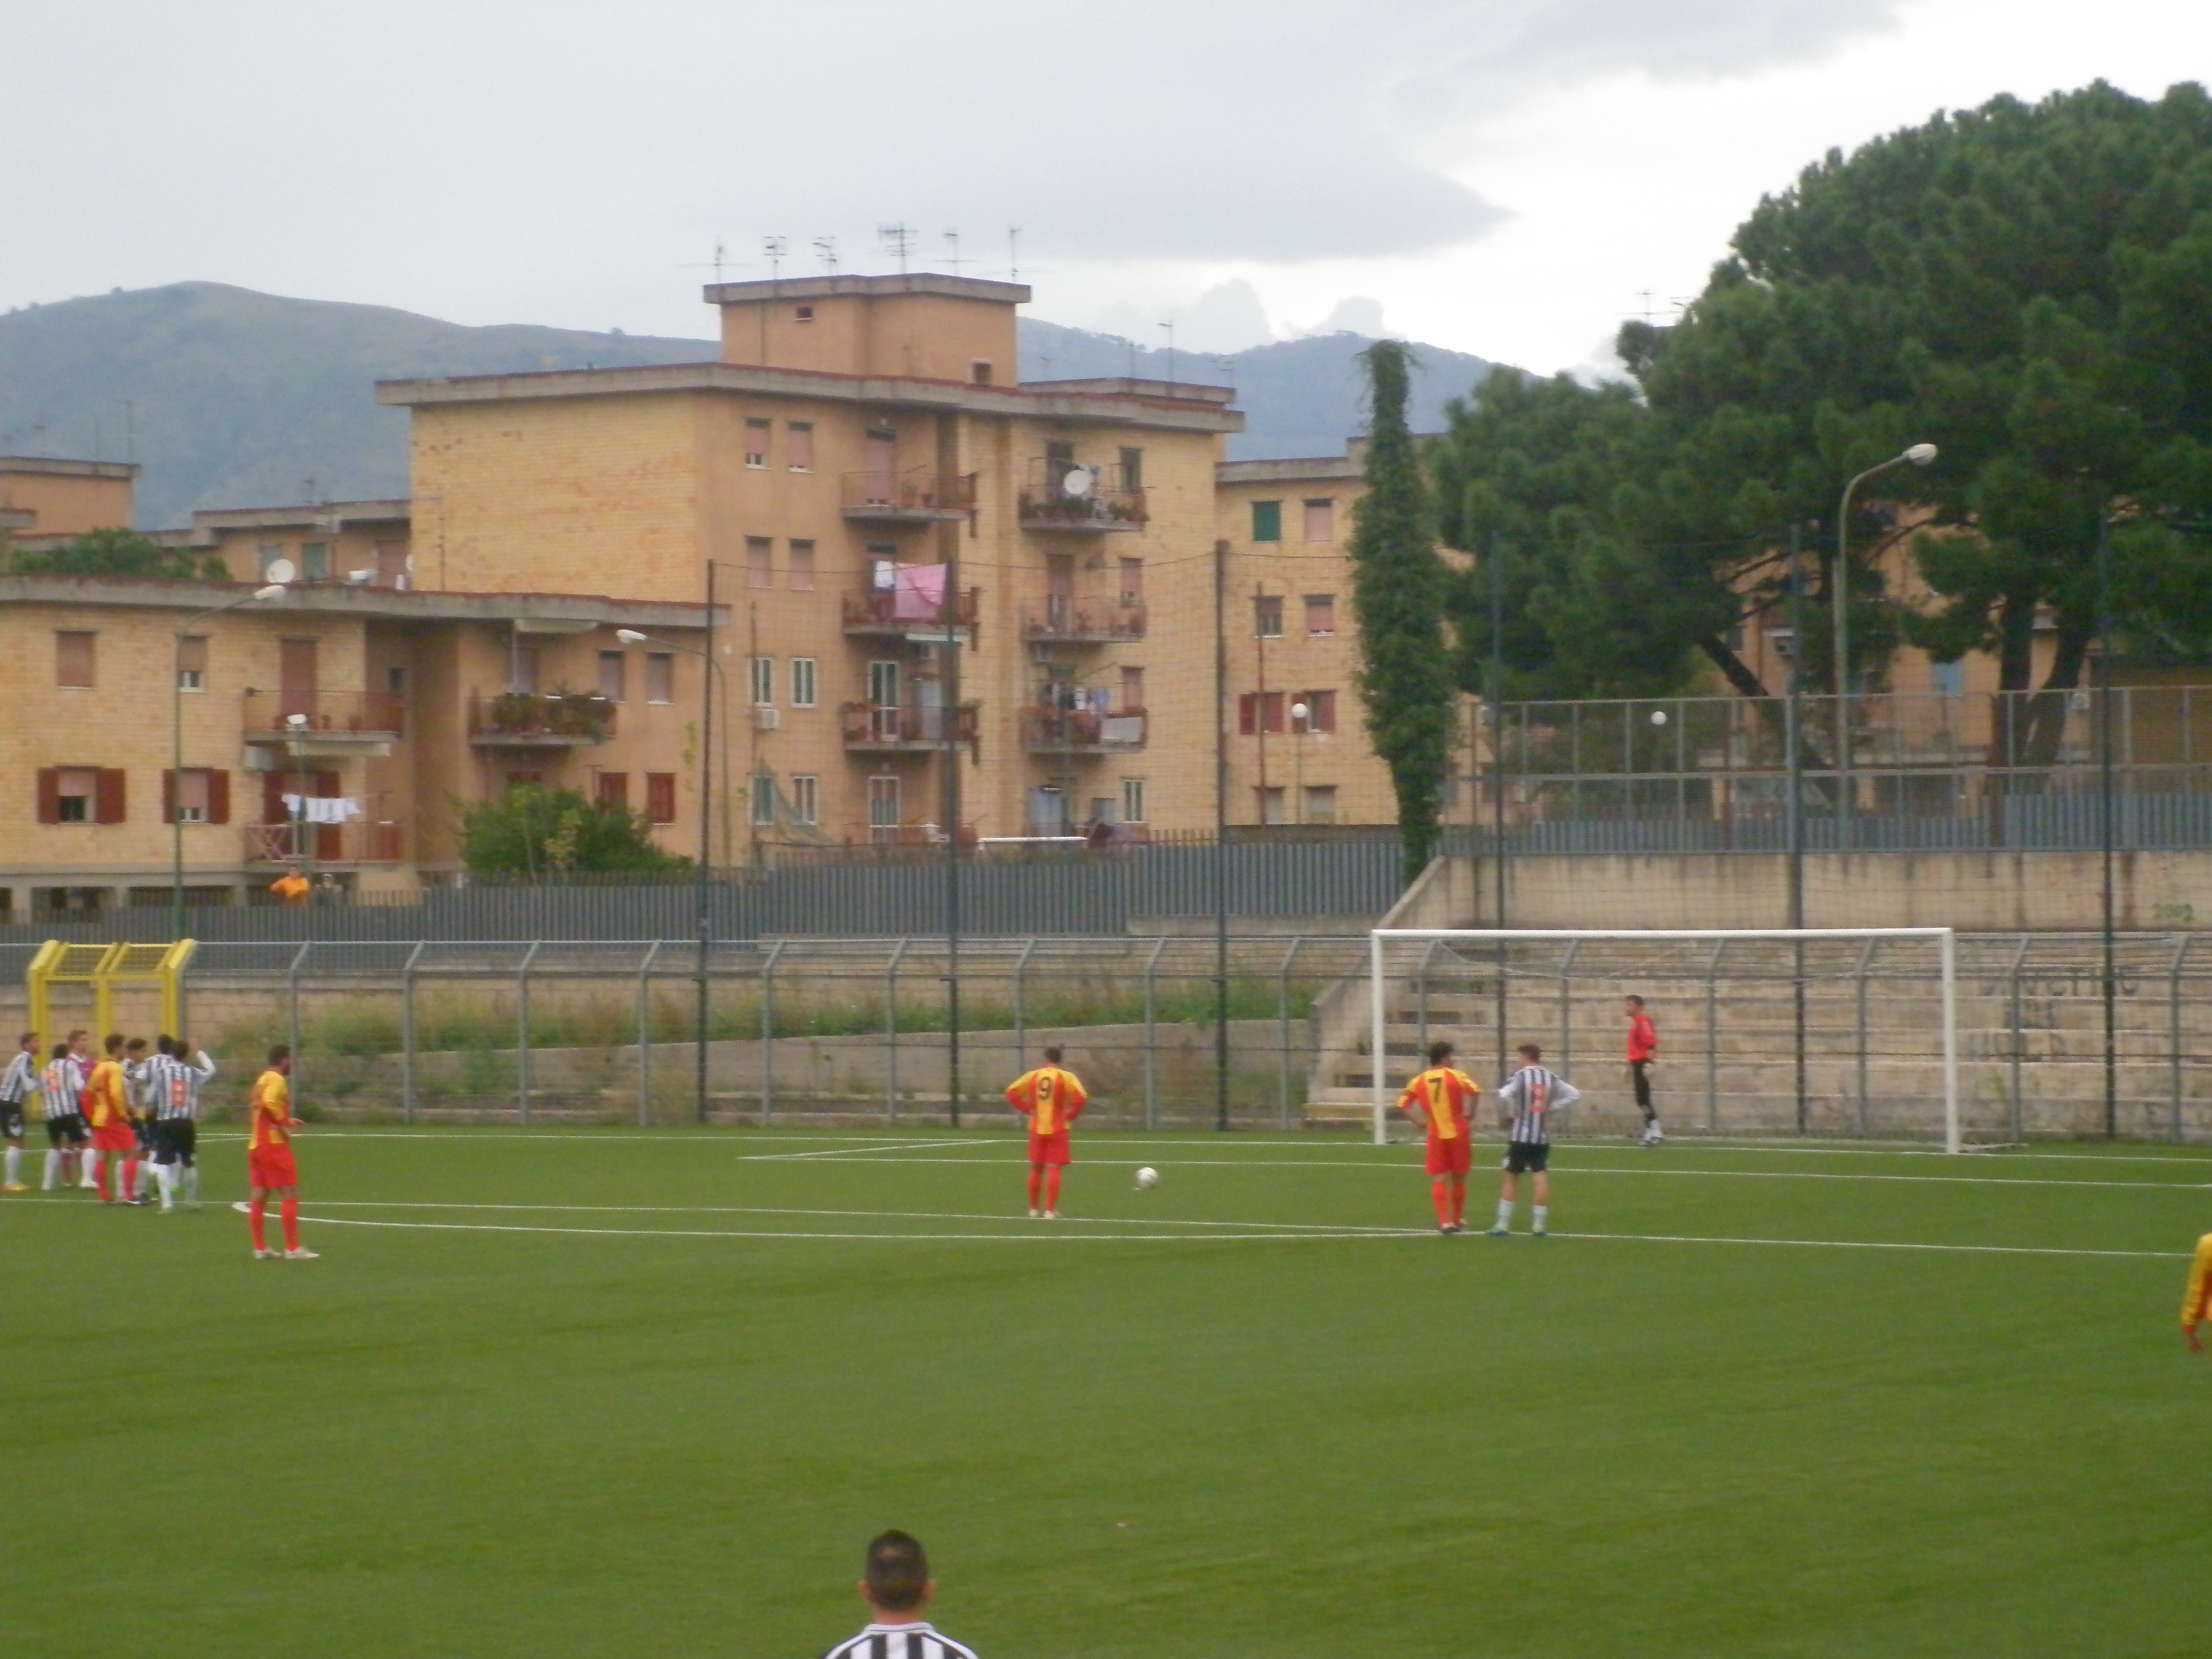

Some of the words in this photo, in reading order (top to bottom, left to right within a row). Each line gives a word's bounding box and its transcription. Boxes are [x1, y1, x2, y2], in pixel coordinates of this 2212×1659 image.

[1039, 1076, 1053, 1100] 9
[1428, 1077, 1444, 1103] 7
[1529, 1083, 1546, 1113] 3
